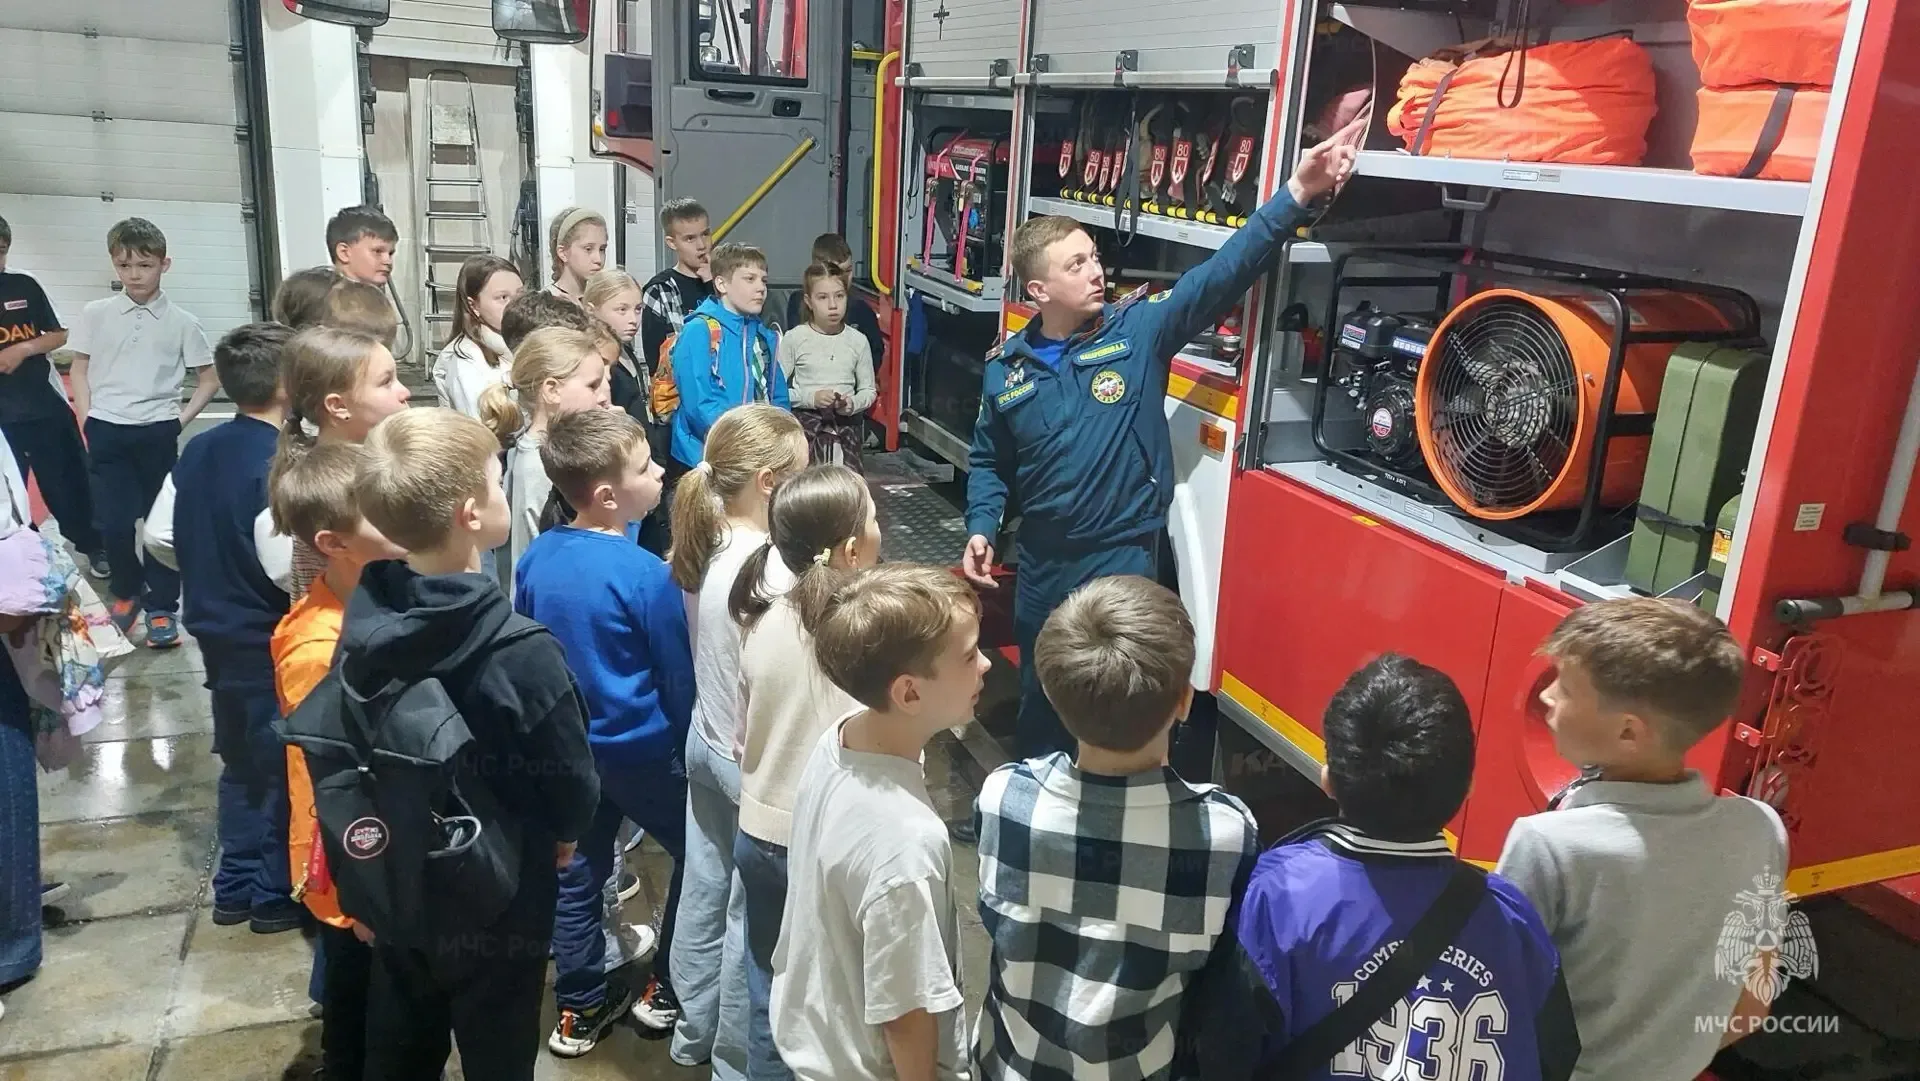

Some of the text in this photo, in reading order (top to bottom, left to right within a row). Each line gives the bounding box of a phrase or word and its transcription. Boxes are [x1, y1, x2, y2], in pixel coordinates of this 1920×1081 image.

[1063, 142, 1072, 154] 50
[1177, 144, 1189, 157] 80
[1240, 140, 1252, 153] 80
[1155, 148, 1165, 160] 80
[1330, 981, 1509, 1081] 1936
